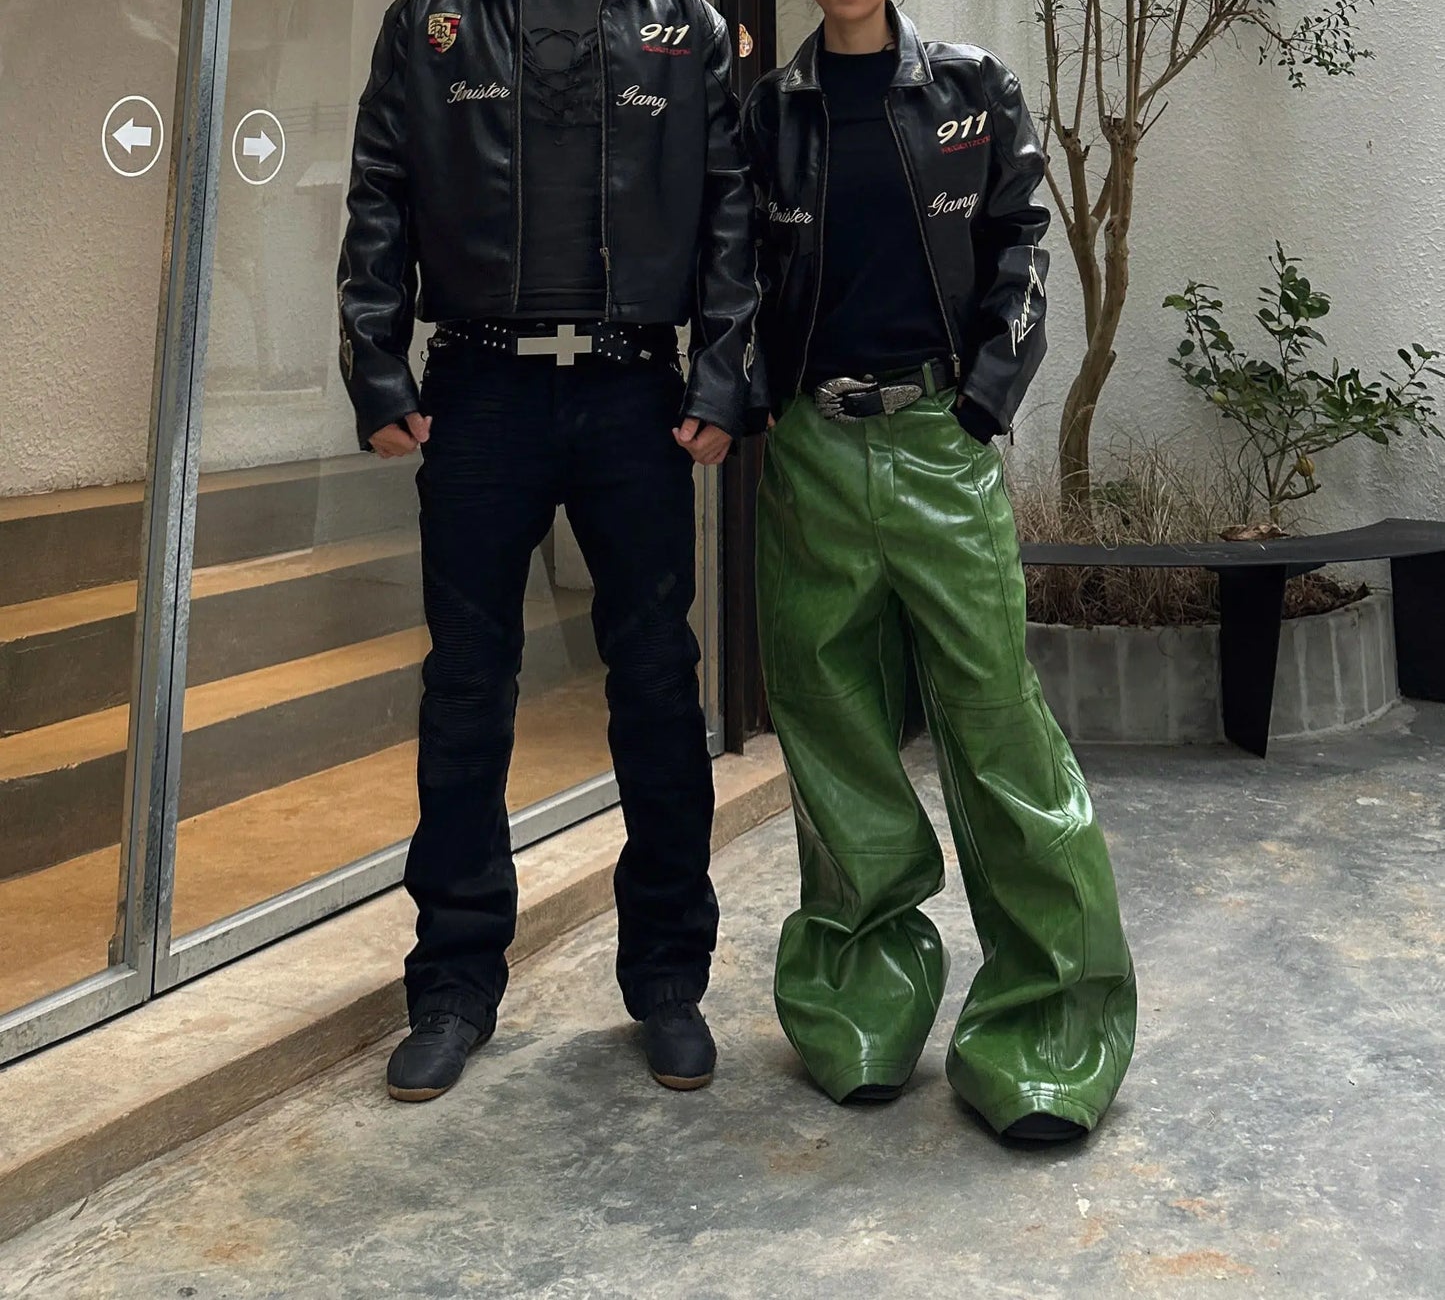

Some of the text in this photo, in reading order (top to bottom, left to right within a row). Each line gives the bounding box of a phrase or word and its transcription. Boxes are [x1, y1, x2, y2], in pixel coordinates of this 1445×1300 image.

[640, 23, 690, 46] 911
[615, 84, 668, 117] Gang
[936, 110, 988, 145] 911
[927, 191, 979, 219] Gang
